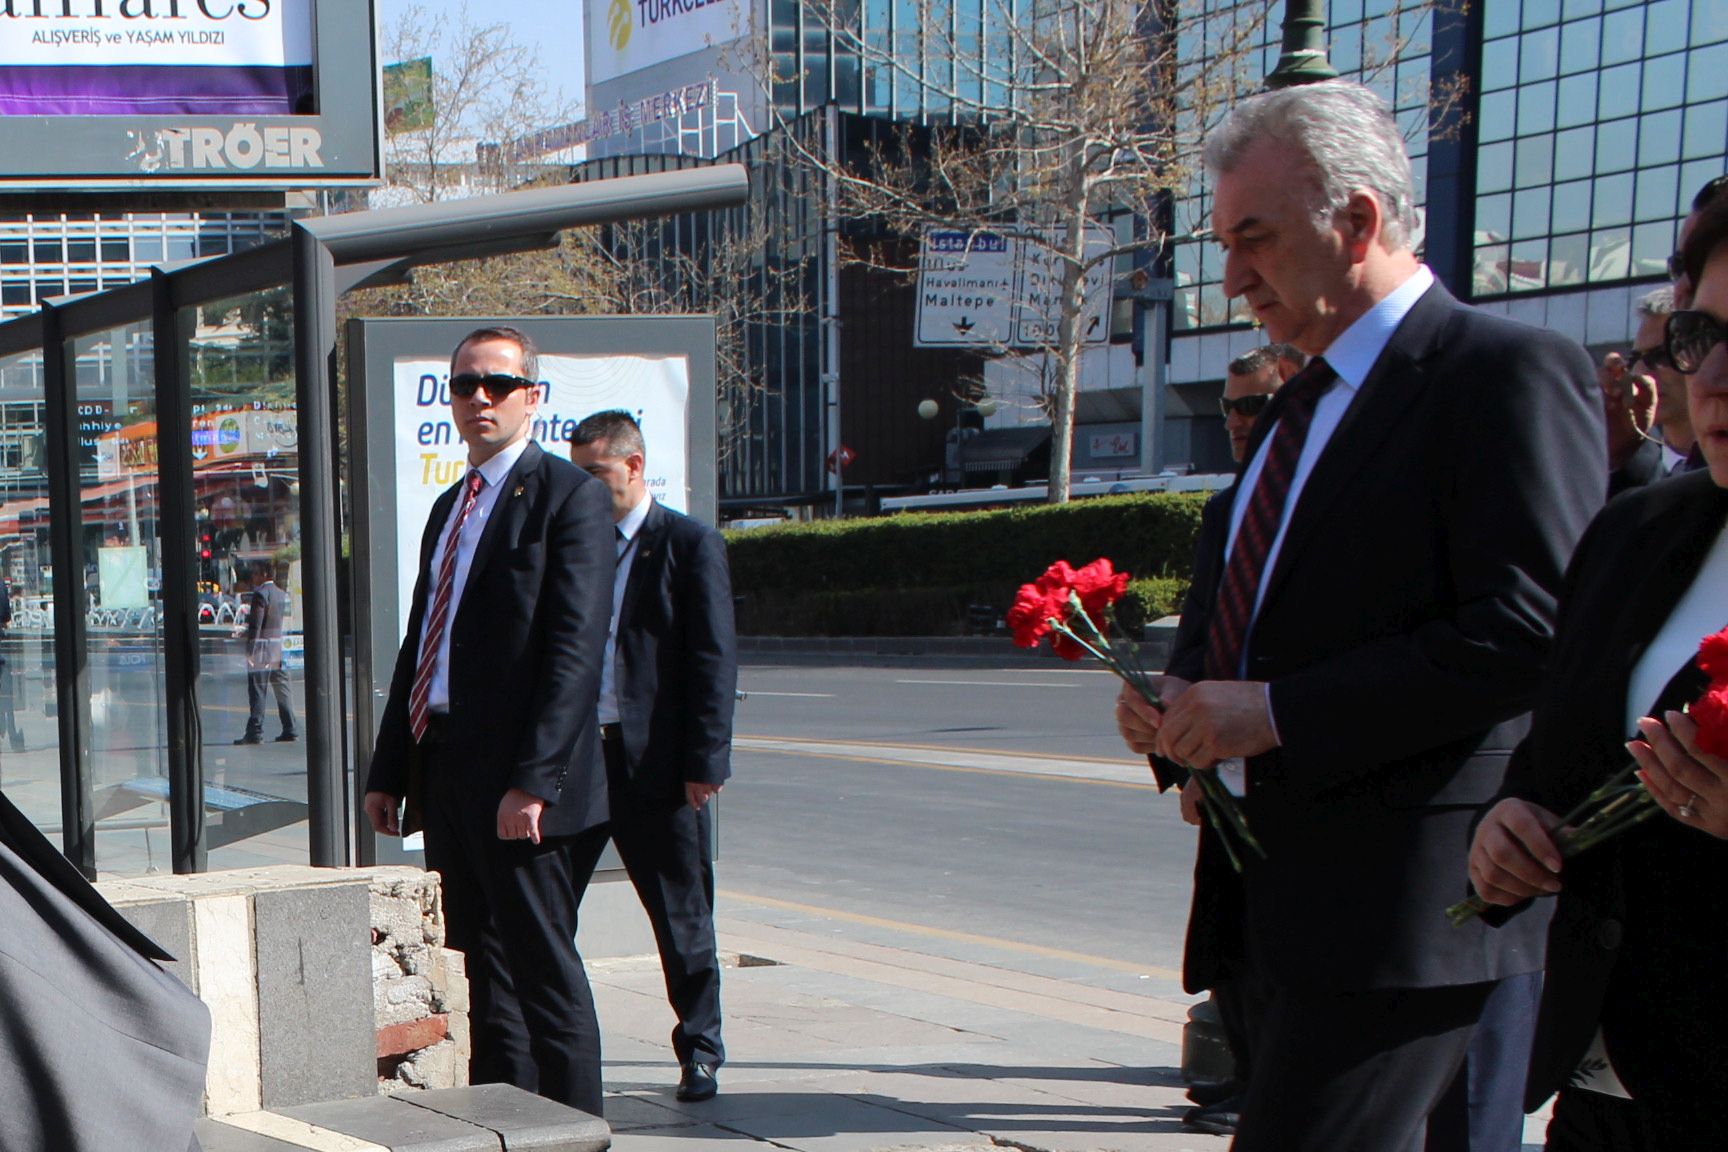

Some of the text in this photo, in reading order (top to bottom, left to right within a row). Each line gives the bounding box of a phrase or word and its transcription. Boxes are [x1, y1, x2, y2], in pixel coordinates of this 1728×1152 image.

[32, 27, 225, 47] ALIŞVERİŞ ve YAŞAM YILDIZI
[127, 122, 325, 171] TRÖER
[925, 293, 995, 310] Maltepe
[417, 420, 451, 445] en
